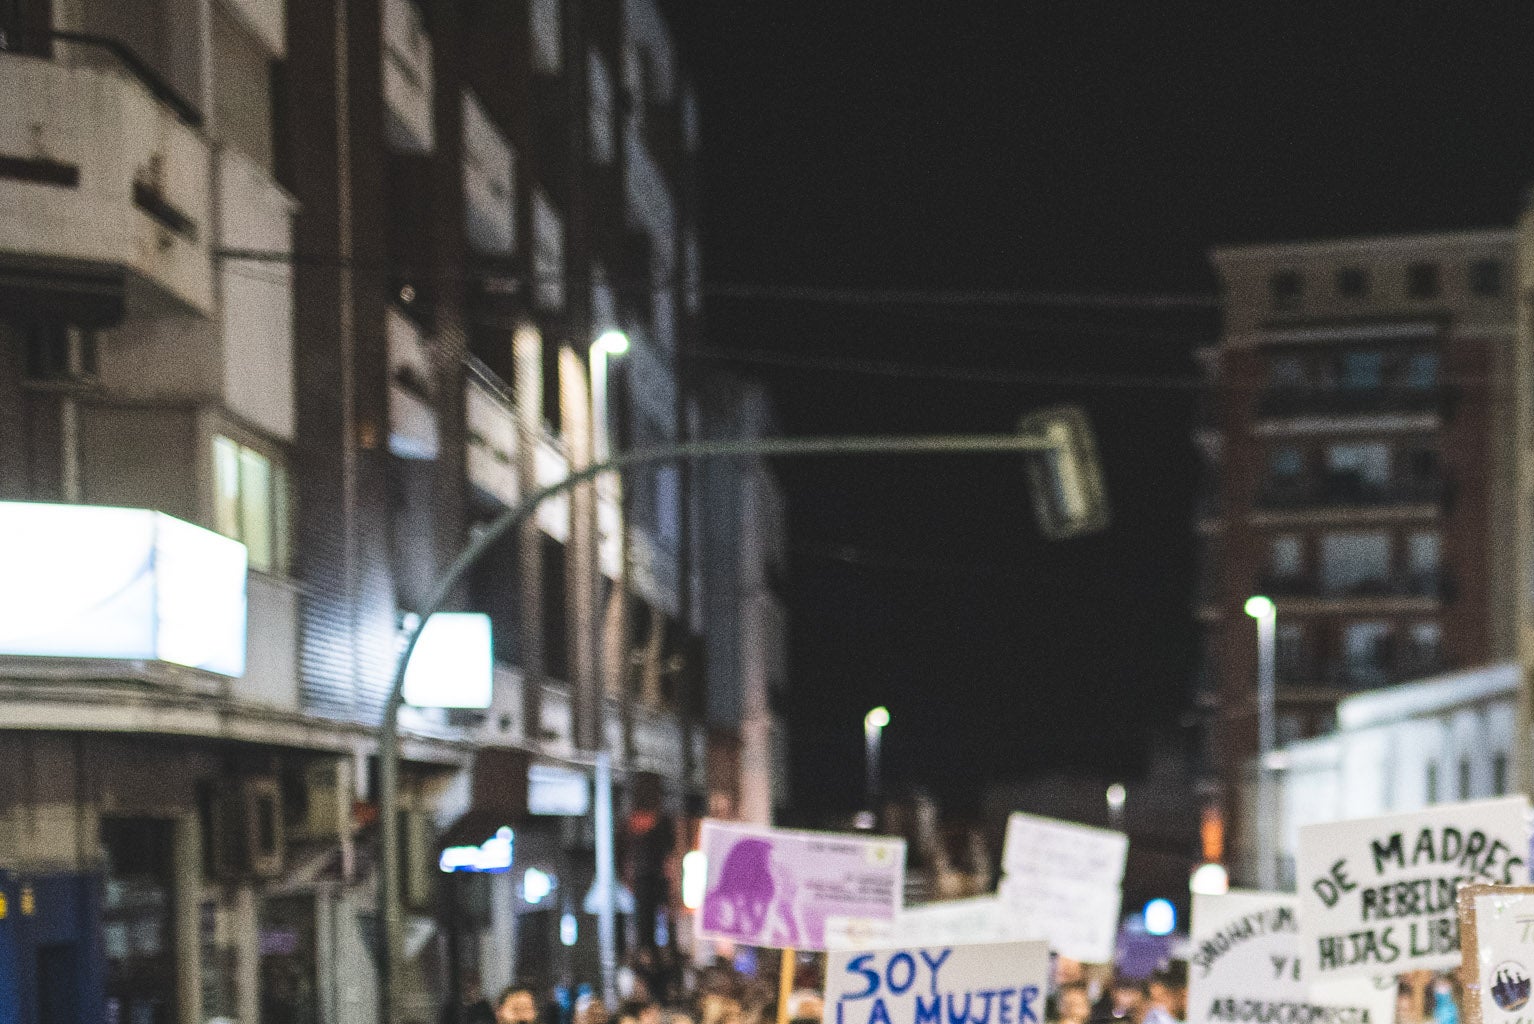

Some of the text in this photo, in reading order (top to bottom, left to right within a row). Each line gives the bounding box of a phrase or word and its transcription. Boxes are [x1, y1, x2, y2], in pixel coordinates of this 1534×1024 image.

[1312, 858, 1358, 908] DE
[1318, 926, 1401, 971] HIJAS
[840, 948, 952, 1000] SOY
